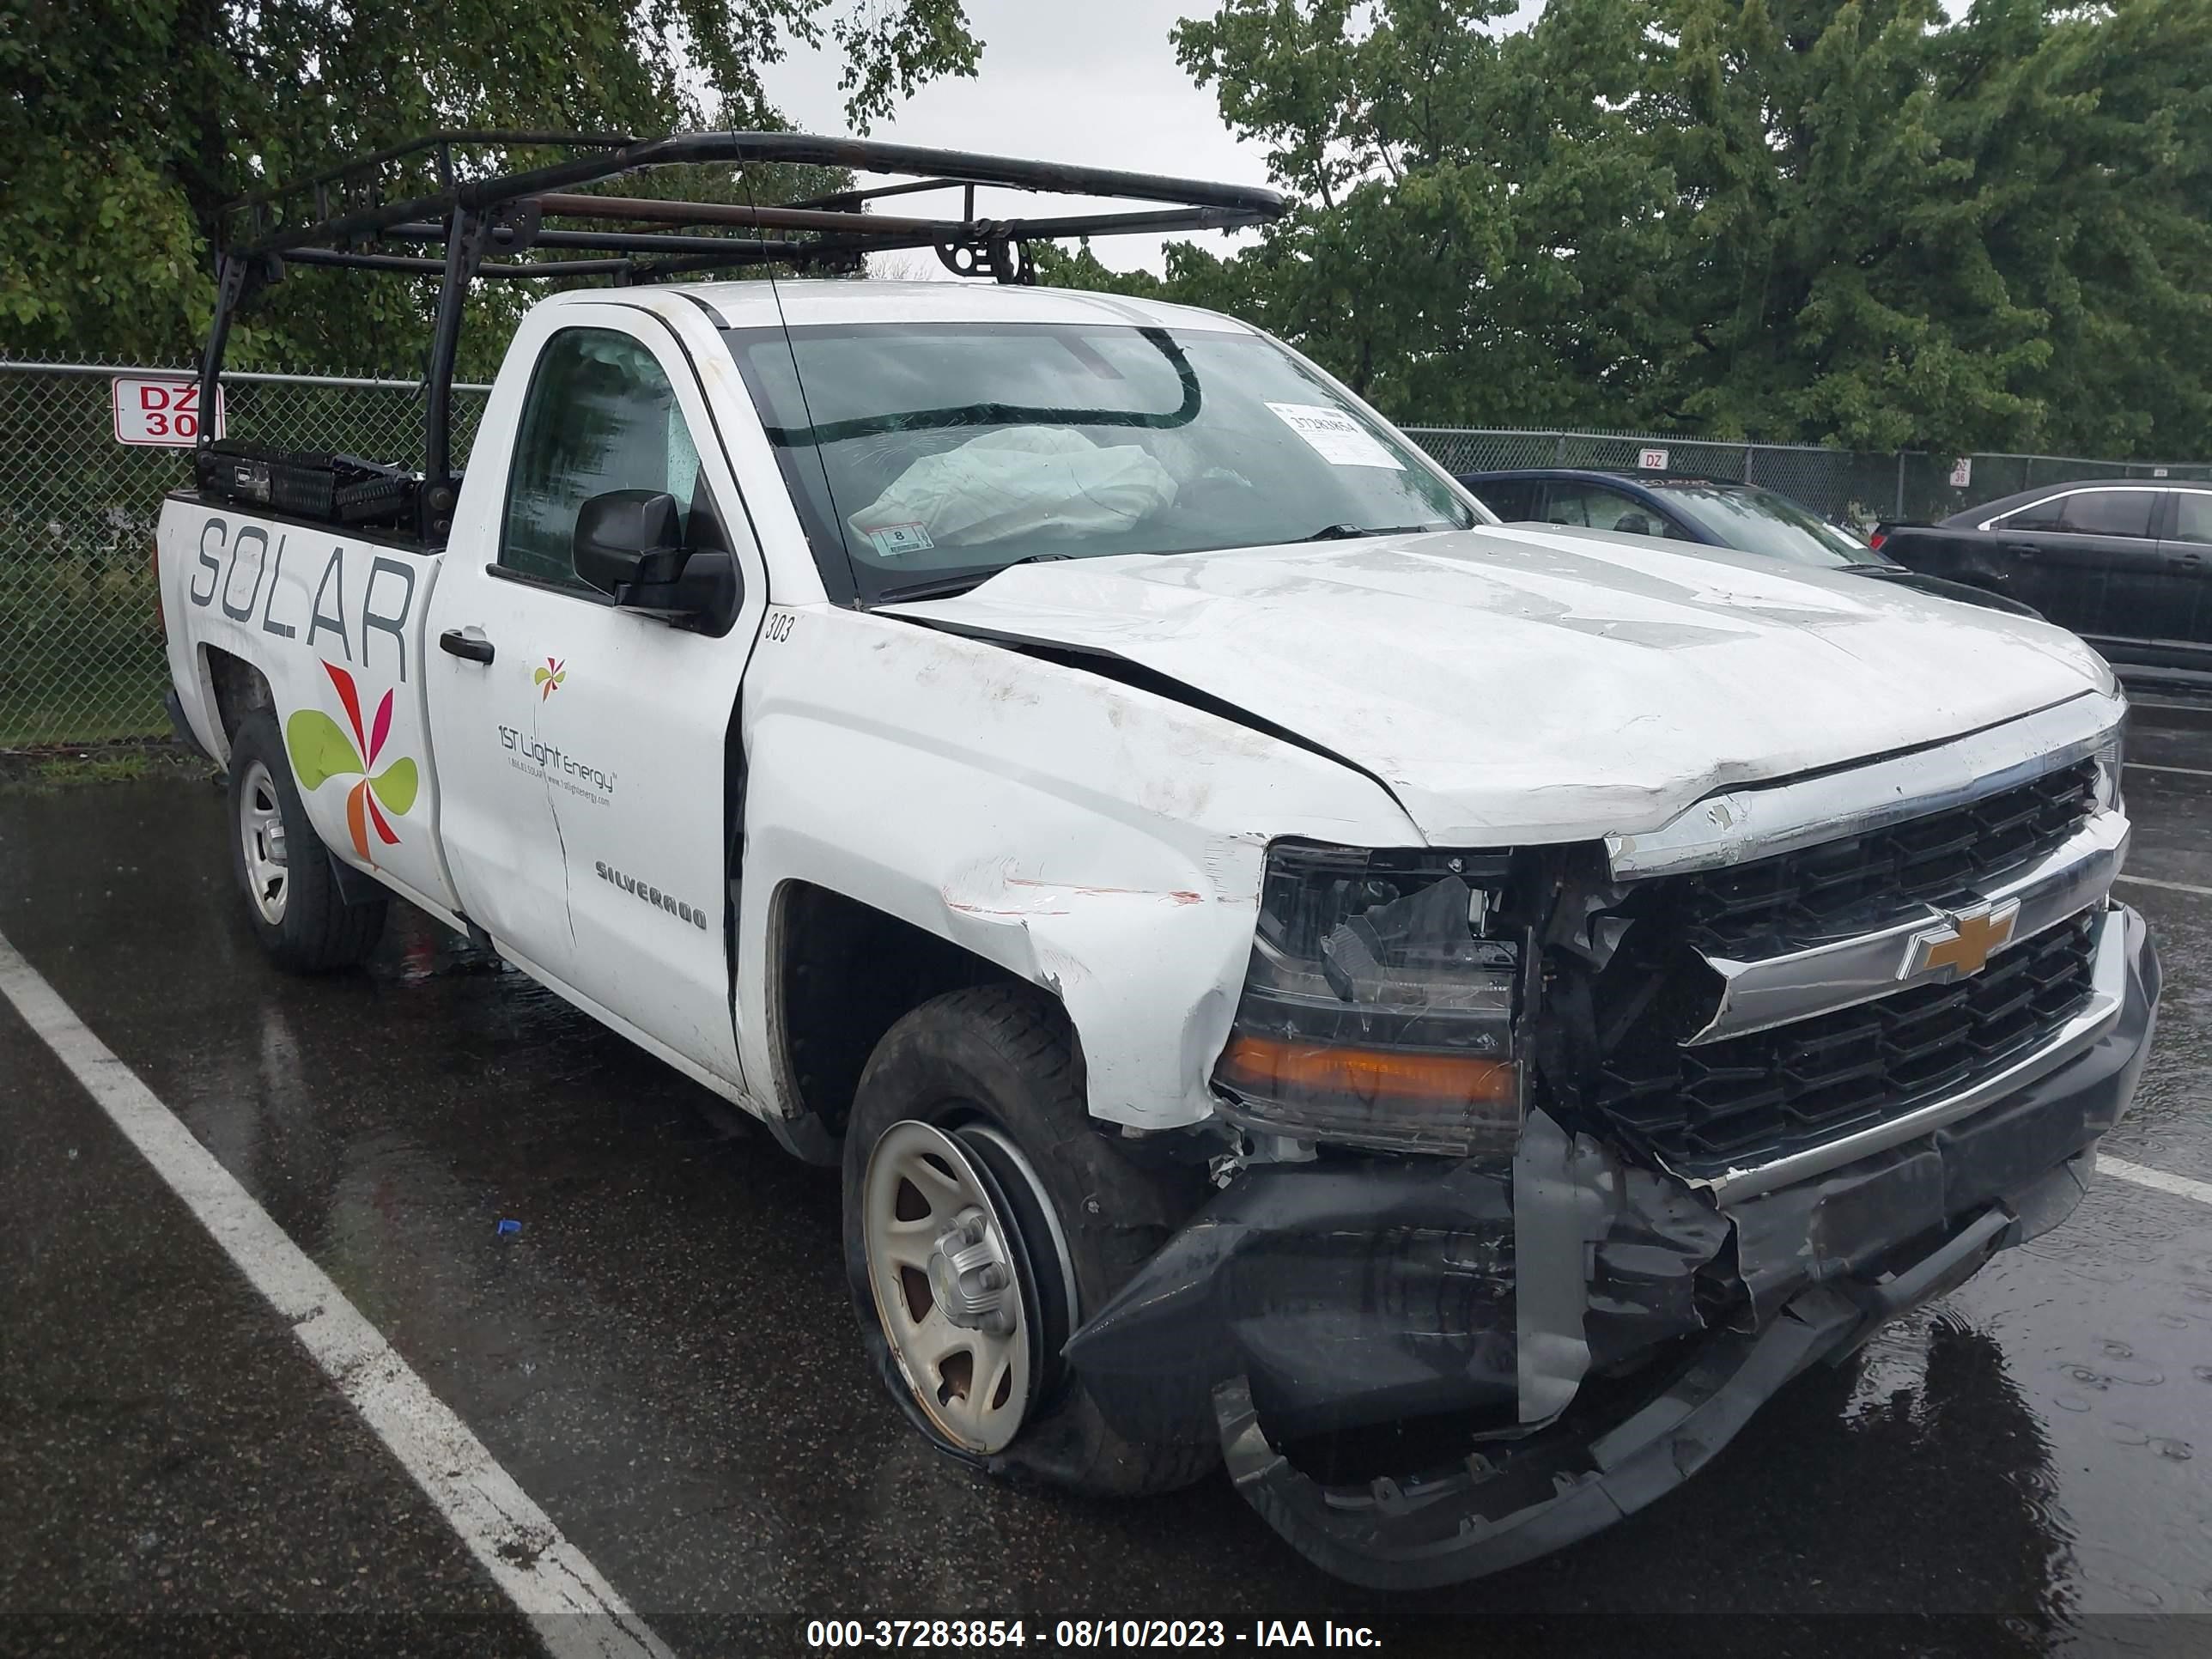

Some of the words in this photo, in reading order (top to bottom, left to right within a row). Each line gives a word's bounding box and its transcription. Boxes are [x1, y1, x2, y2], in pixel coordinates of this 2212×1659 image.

[140, 386, 199, 412] DZ
[145, 412, 198, 437] 30
[1645, 454, 1662, 467] DZ
[1954, 471, 1966, 483] 36
[894, 531, 905, 541] 8
[190, 517, 416, 683] SOLAR
[765, 612, 795, 643] 303
[498, 725, 520, 751] 1ST
[520, 732, 562, 769] Light
[595, 860, 707, 930] SILVERADO
